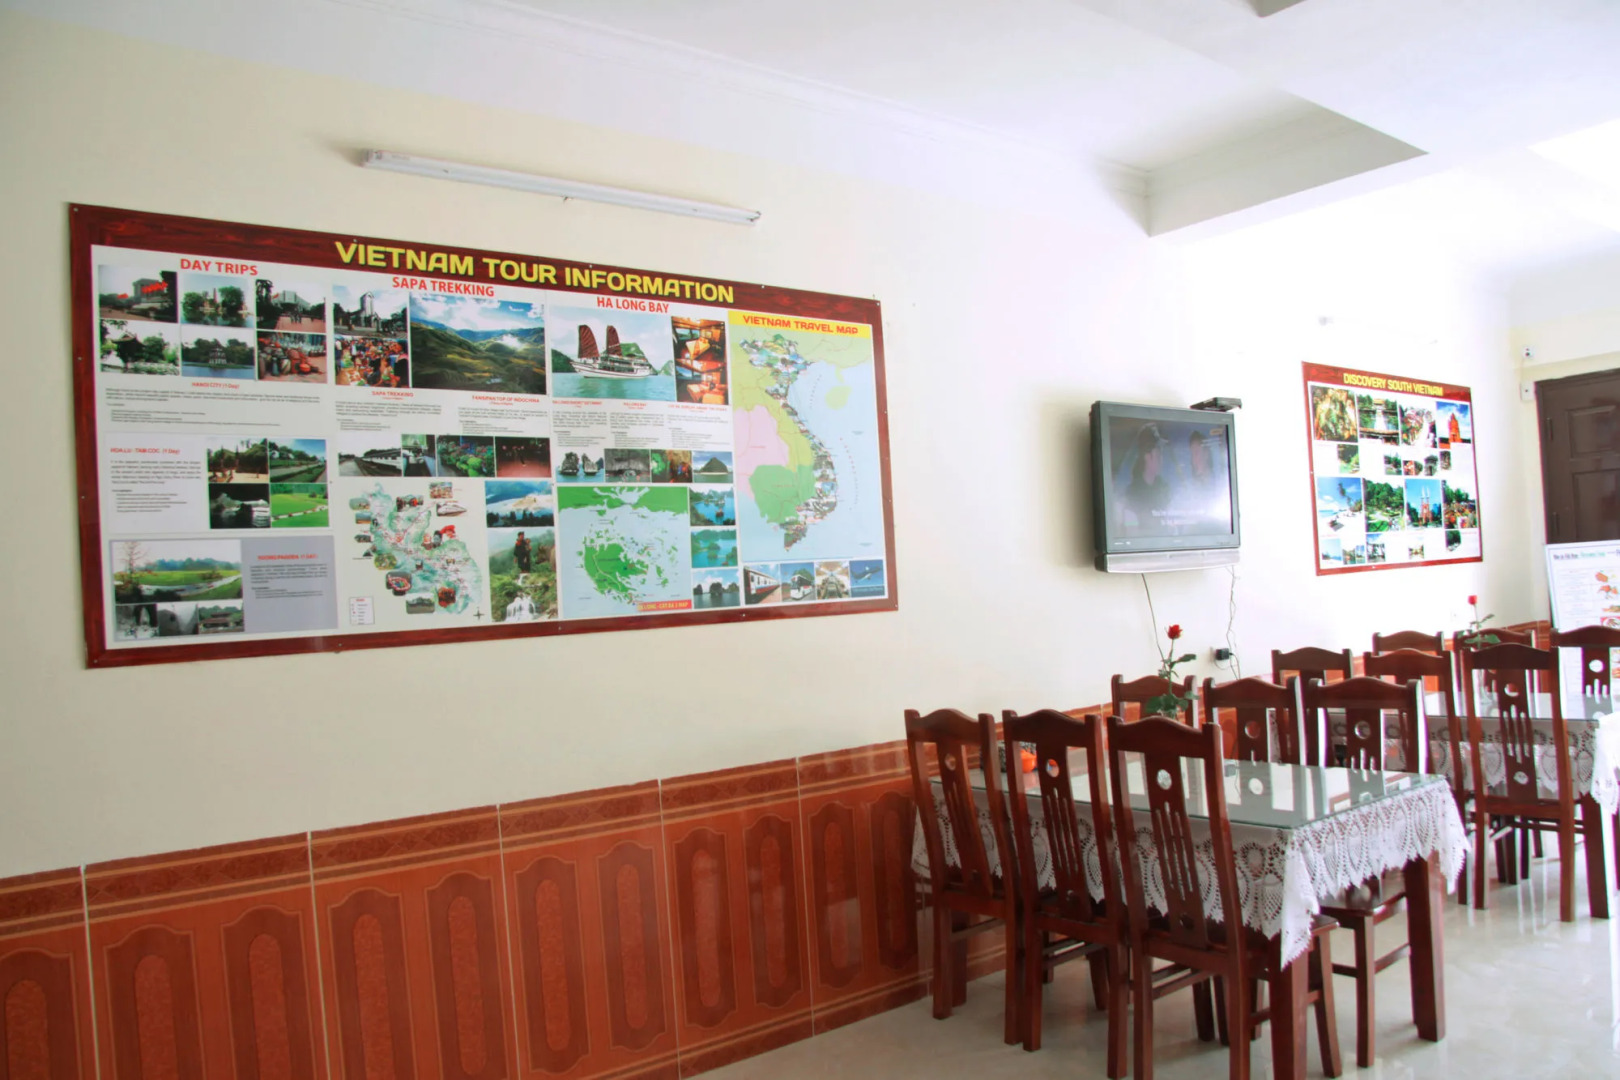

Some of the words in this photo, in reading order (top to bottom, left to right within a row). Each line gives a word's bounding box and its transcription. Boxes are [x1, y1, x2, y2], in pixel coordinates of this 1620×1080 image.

[180, 257, 212, 272] DAY
[215, 261, 258, 276] TRIPS
[334, 242, 474, 277] VIETNAM
[482, 256, 557, 285] TOUR
[565, 266, 734, 304] INFORMATION
[392, 276, 428, 291] SAPA
[430, 279, 494, 297] TREKKING
[596, 296, 613, 310] HA
[616, 298, 646, 312] LONG
[648, 300, 670, 314] BAY
[742, 314, 792, 330] VIETNAM
[794, 319, 833, 334] TRAVEL
[836, 323, 858, 336] MAP
[1342, 372, 1387, 390] DISCOVERY
[1388, 378, 1412, 392] SOUTH
[1413, 382, 1444, 397] VIETNAM
